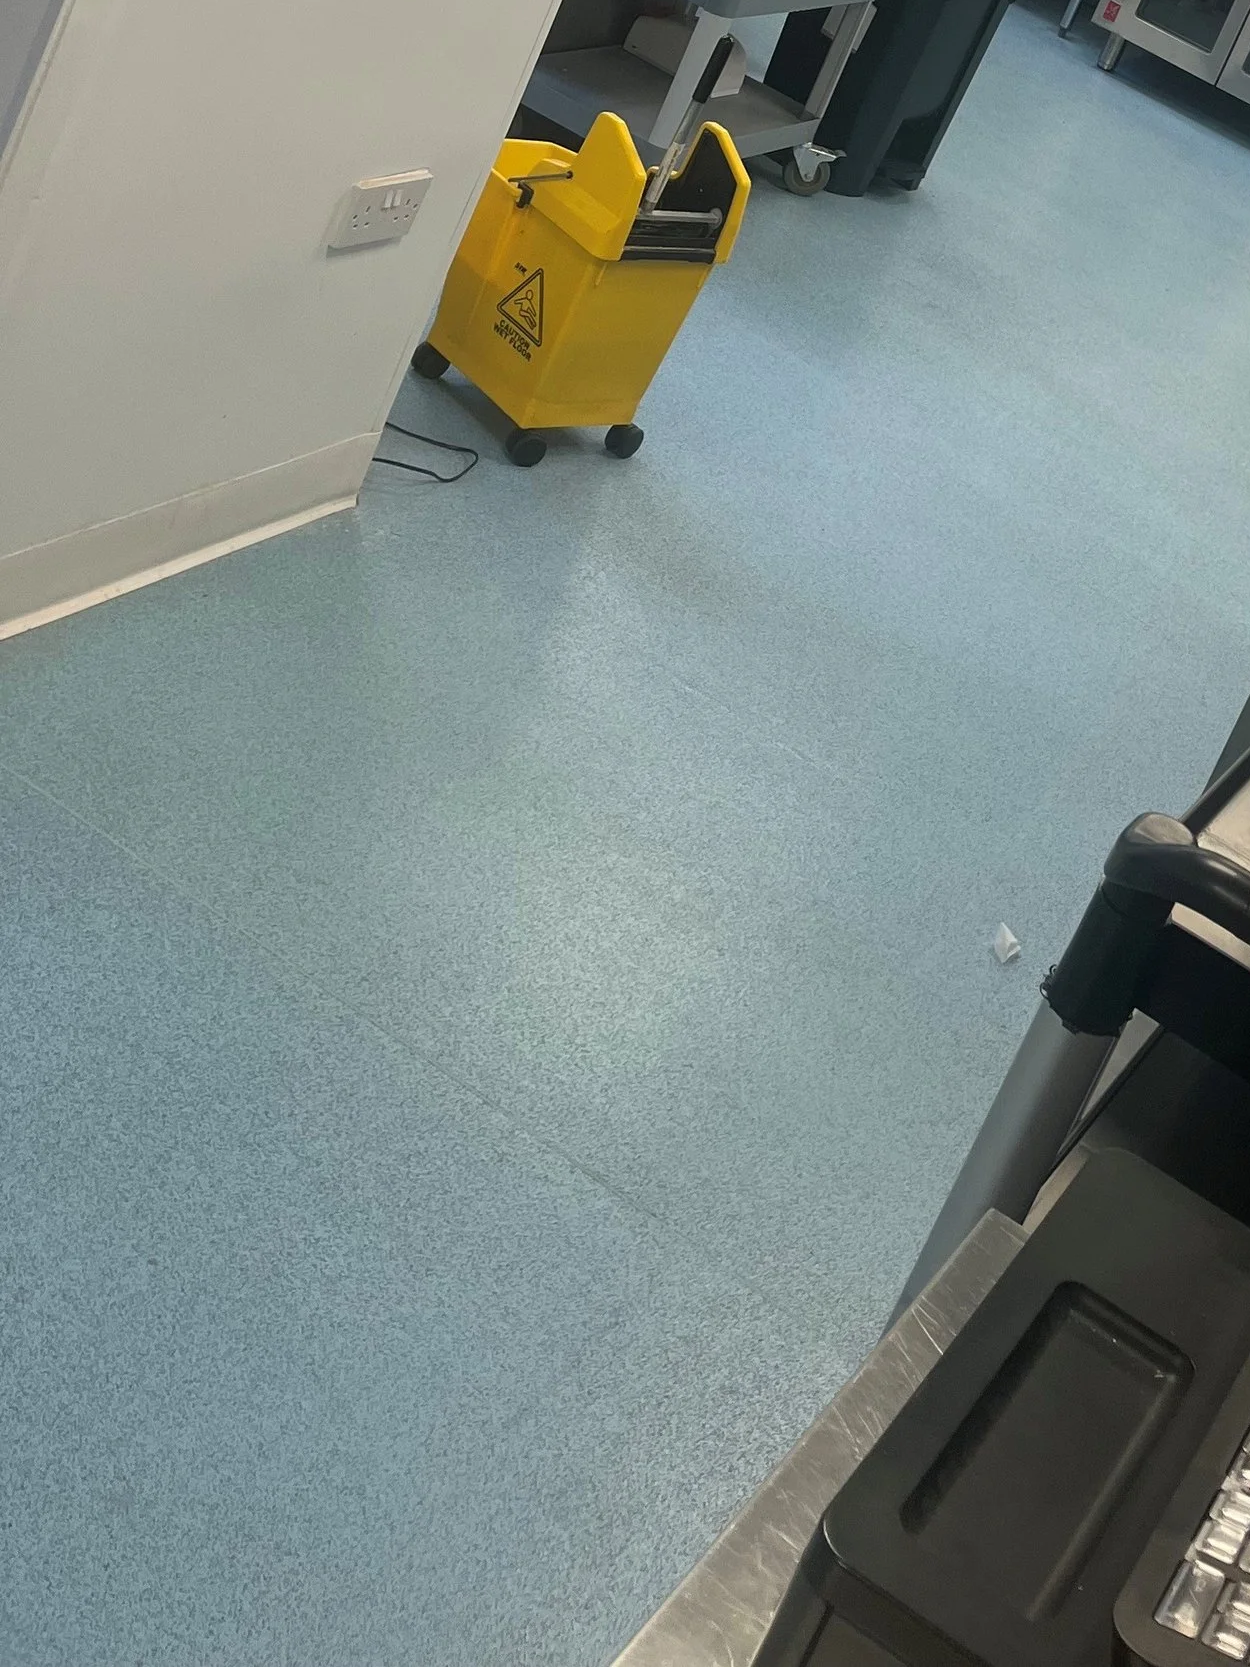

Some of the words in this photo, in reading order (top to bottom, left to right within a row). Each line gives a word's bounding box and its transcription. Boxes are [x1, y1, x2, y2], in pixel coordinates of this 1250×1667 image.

[492, 321, 509, 339] WET
[508, 336, 532, 361] FLOOR
[498, 318, 531, 350] CAUTION
